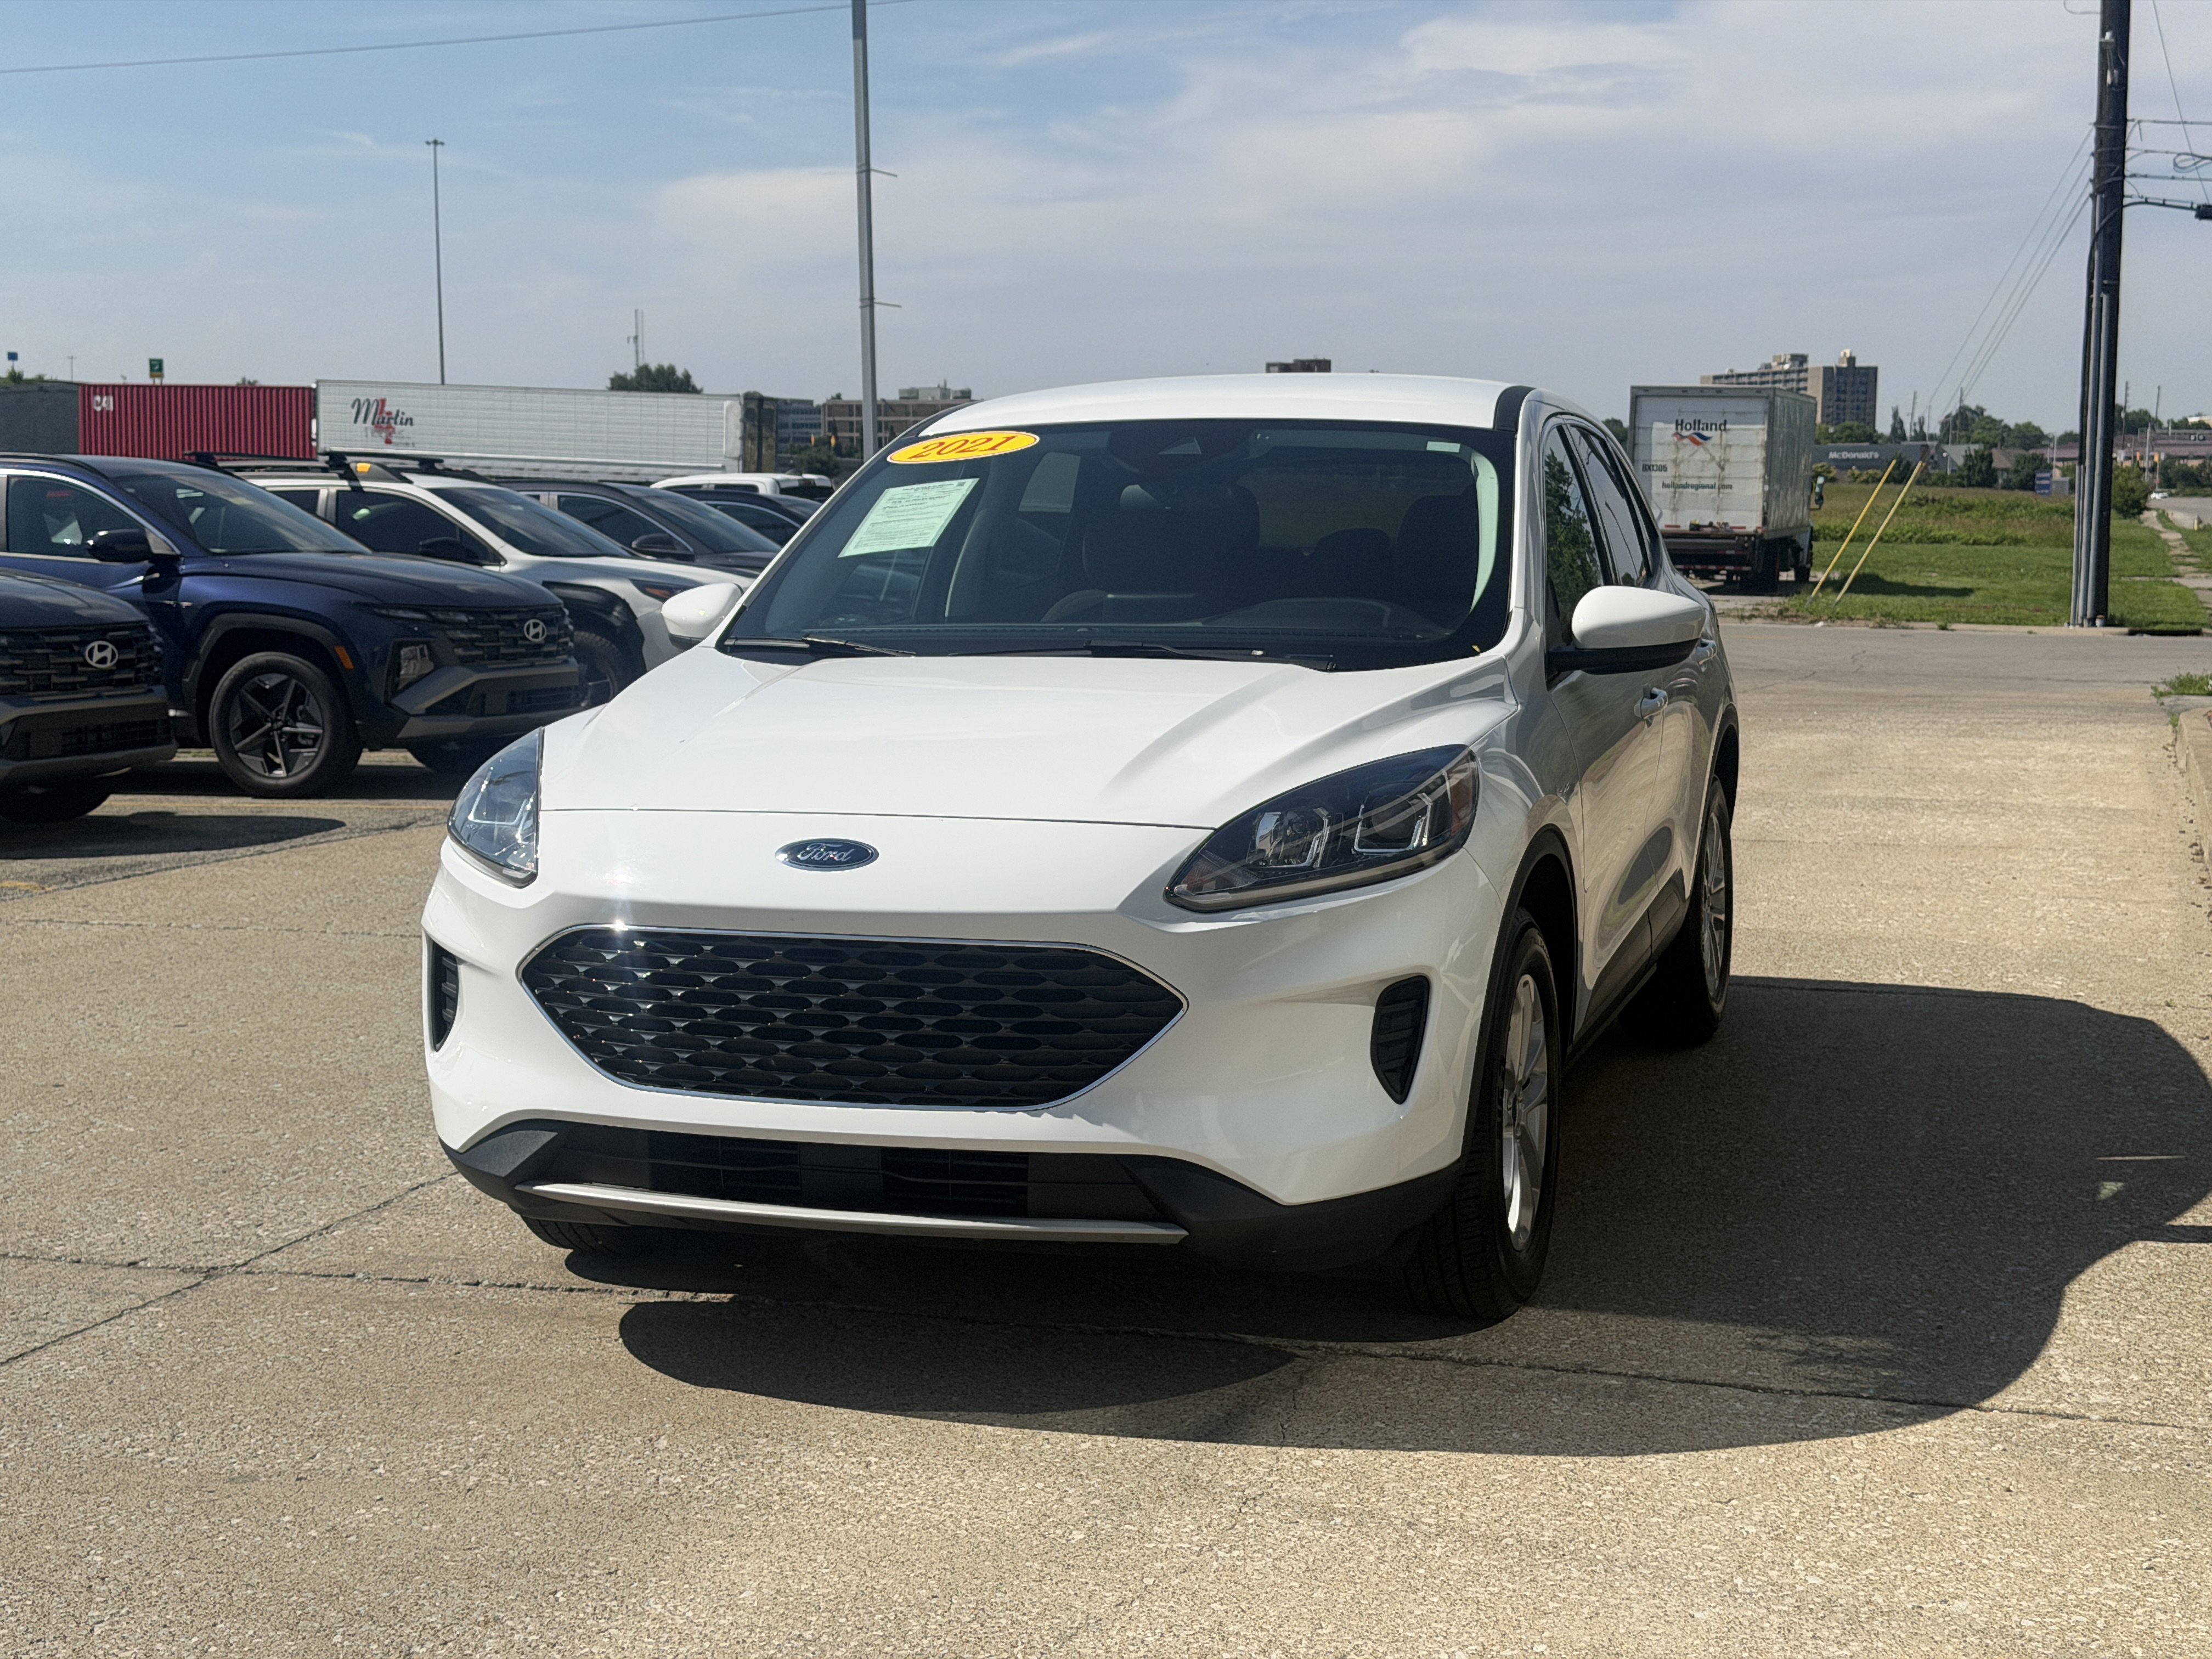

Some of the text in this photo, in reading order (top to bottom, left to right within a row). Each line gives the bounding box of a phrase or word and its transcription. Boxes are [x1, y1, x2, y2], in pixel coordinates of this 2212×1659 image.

[1674, 419, 1728, 432] Holland
[906, 435, 1018, 460] 2021
[797, 842, 855, 862] Ford
